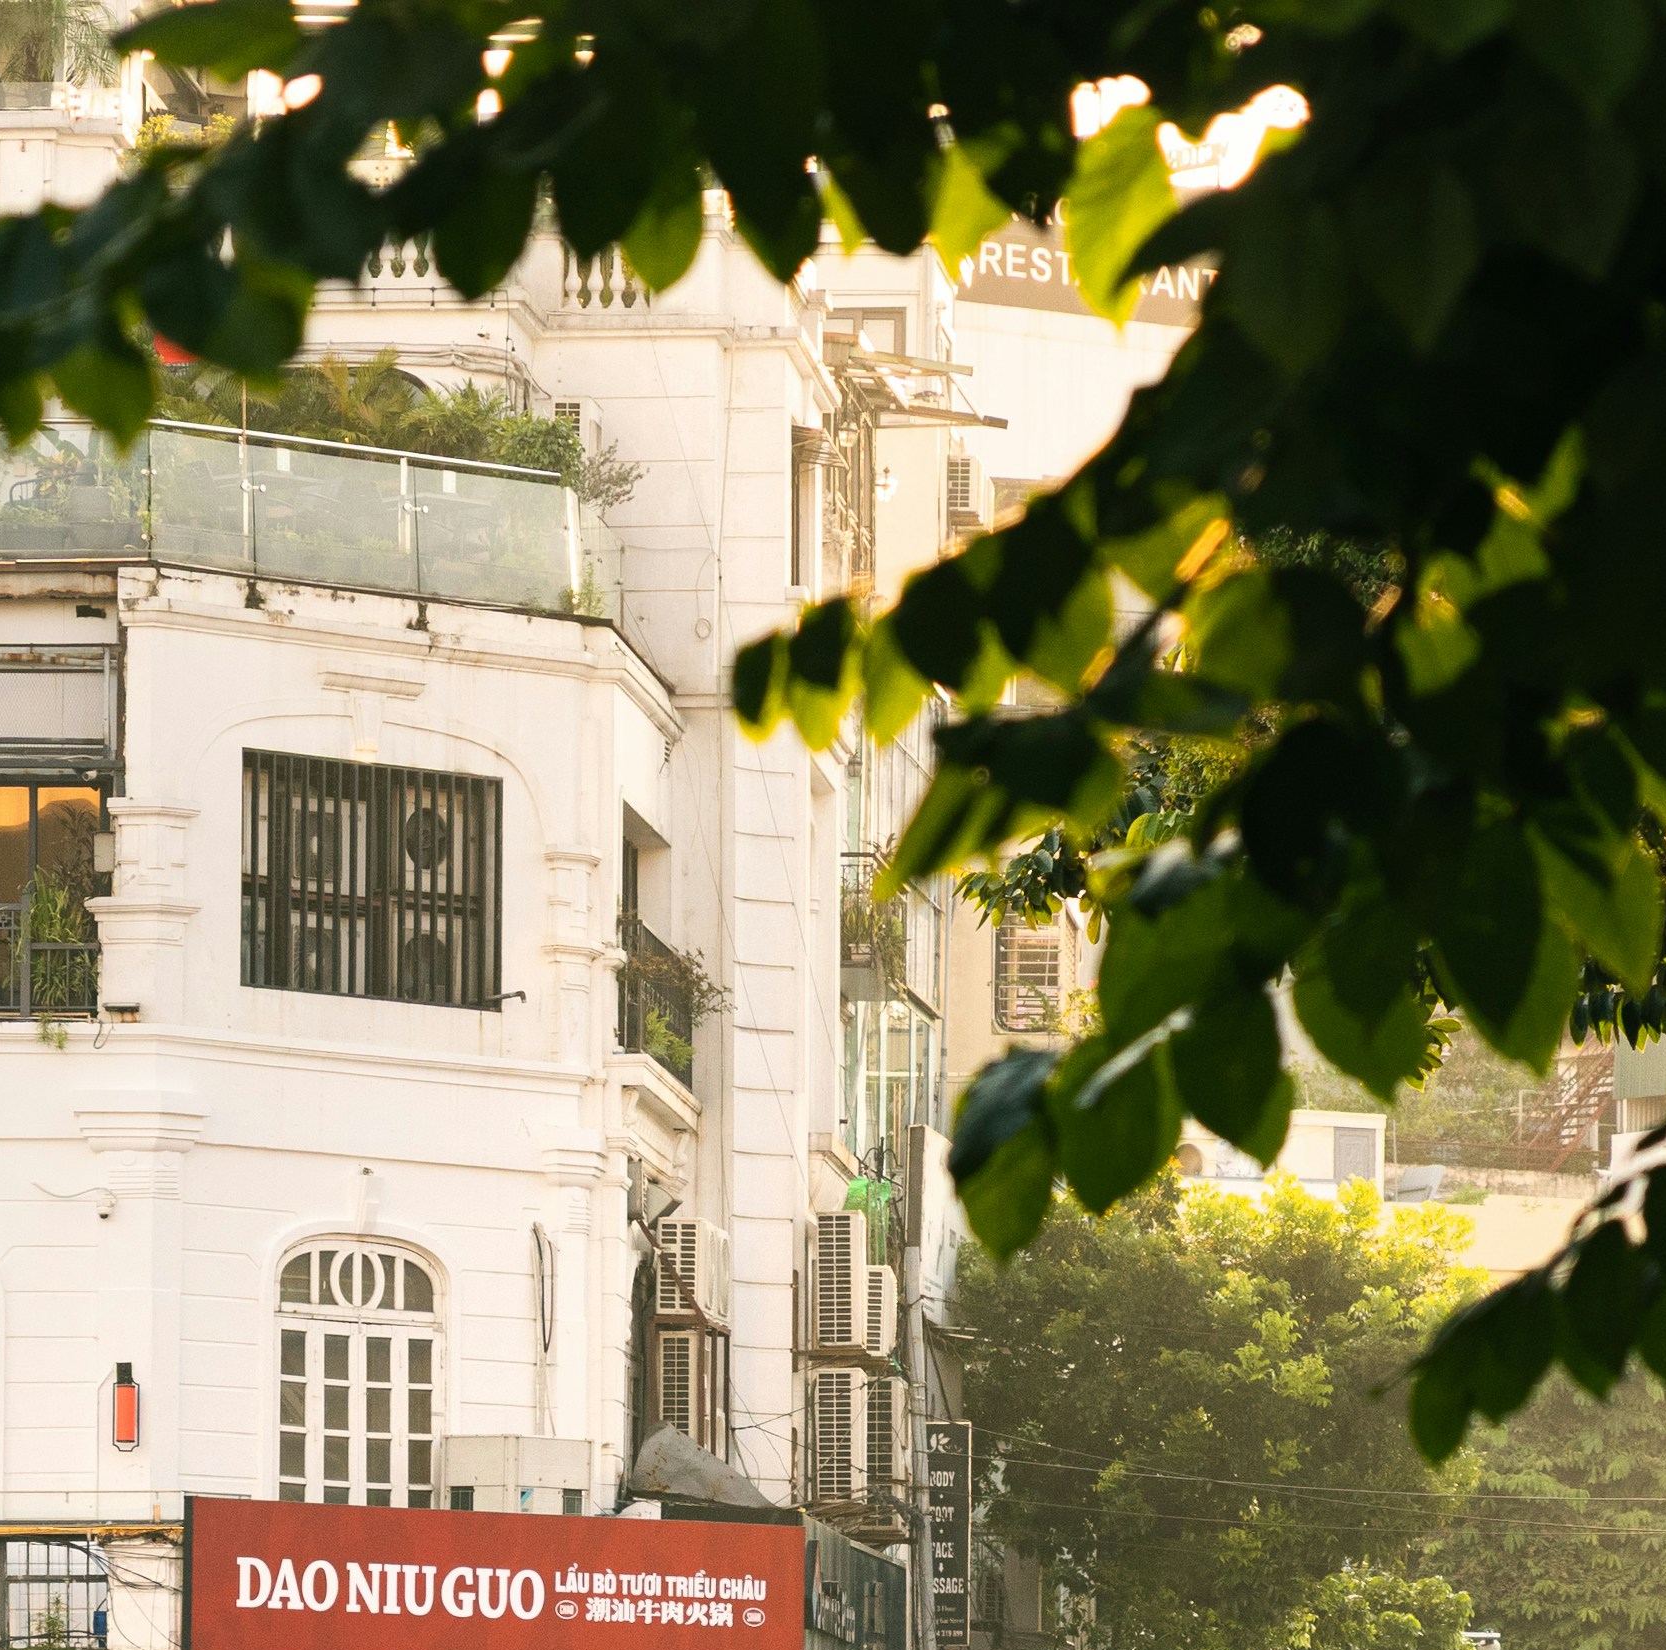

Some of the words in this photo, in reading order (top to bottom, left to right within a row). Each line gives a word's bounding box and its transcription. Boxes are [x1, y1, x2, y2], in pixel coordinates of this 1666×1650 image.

[236, 1556, 338, 1612] DAO
[346, 1562, 437, 1617] NIU
[440, 1567, 546, 1620] GUO
[555, 1563, 590, 1593] LẨU
[593, 1569, 617, 1594] BÒ
[619, 1572, 662, 1596] TƯƠI
[665, 1570, 716, 1599] TRIỀU
[719, 1574, 766, 1600] CHÂU
[933, 1577, 964, 1593] SSAGE
